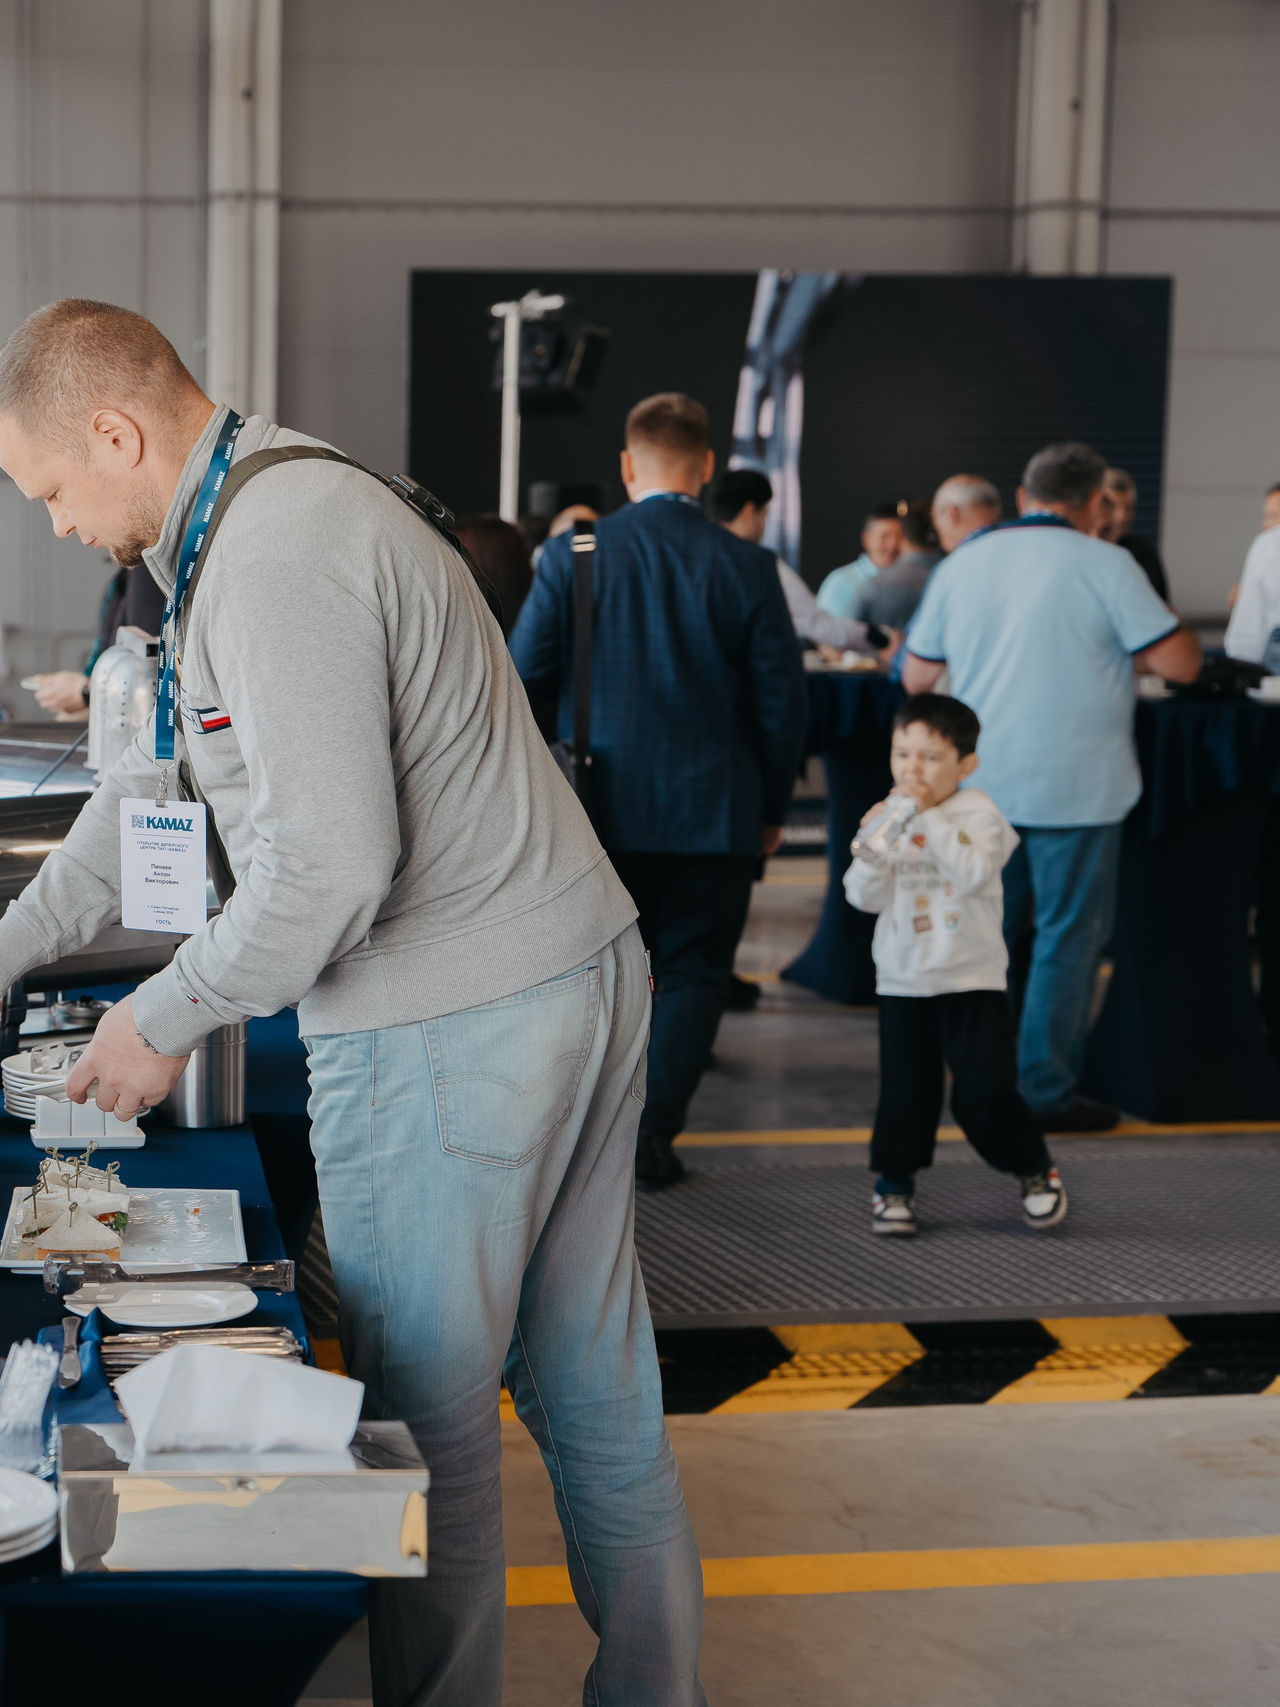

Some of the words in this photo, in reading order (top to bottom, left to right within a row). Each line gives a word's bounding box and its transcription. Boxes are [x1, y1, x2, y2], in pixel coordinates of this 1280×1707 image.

[214, 471, 225, 491] KAMAZ
[203, 502, 214, 523] KAMAZ
[194, 534, 204, 552] KAMAZ
[146, 816, 194, 832] KAMAZ
[144, 877, 179, 885] Викторович
